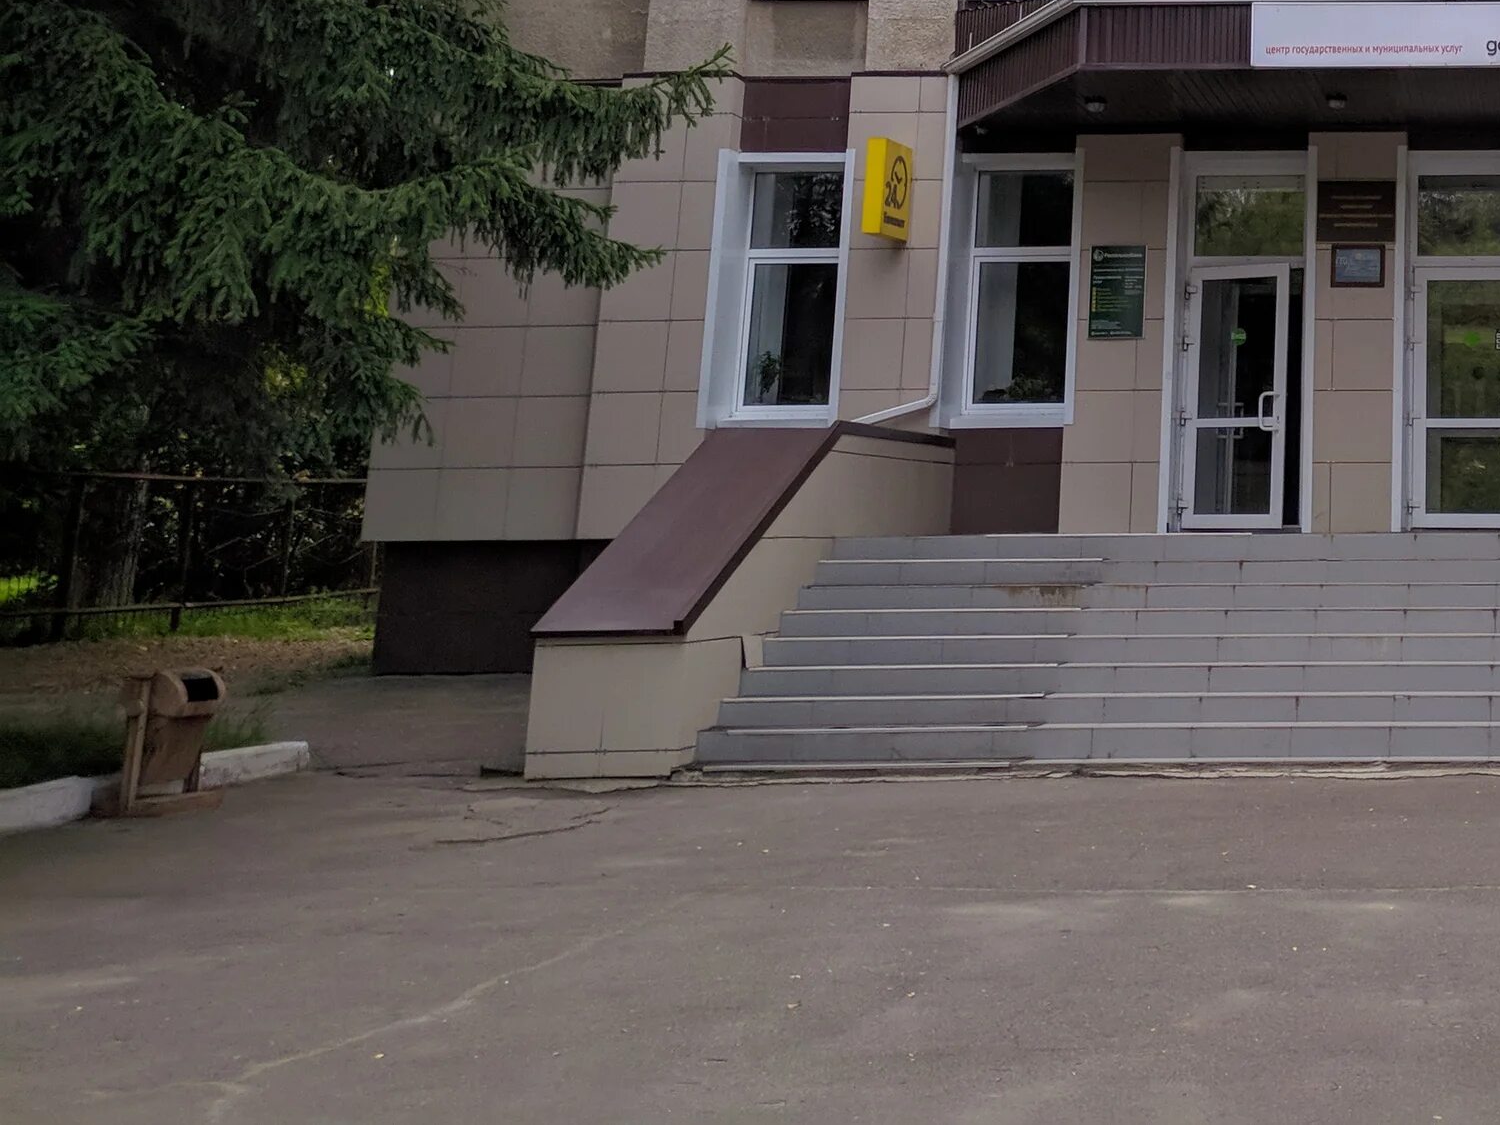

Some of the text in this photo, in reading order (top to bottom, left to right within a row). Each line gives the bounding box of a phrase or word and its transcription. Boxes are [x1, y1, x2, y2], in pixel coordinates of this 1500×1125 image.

[1265, 45, 1290, 55] центр
[1292, 45, 1363, 55] государственных
[1372, 44, 1439, 54] муниципальных
[1441, 44, 1463, 54] услуг
